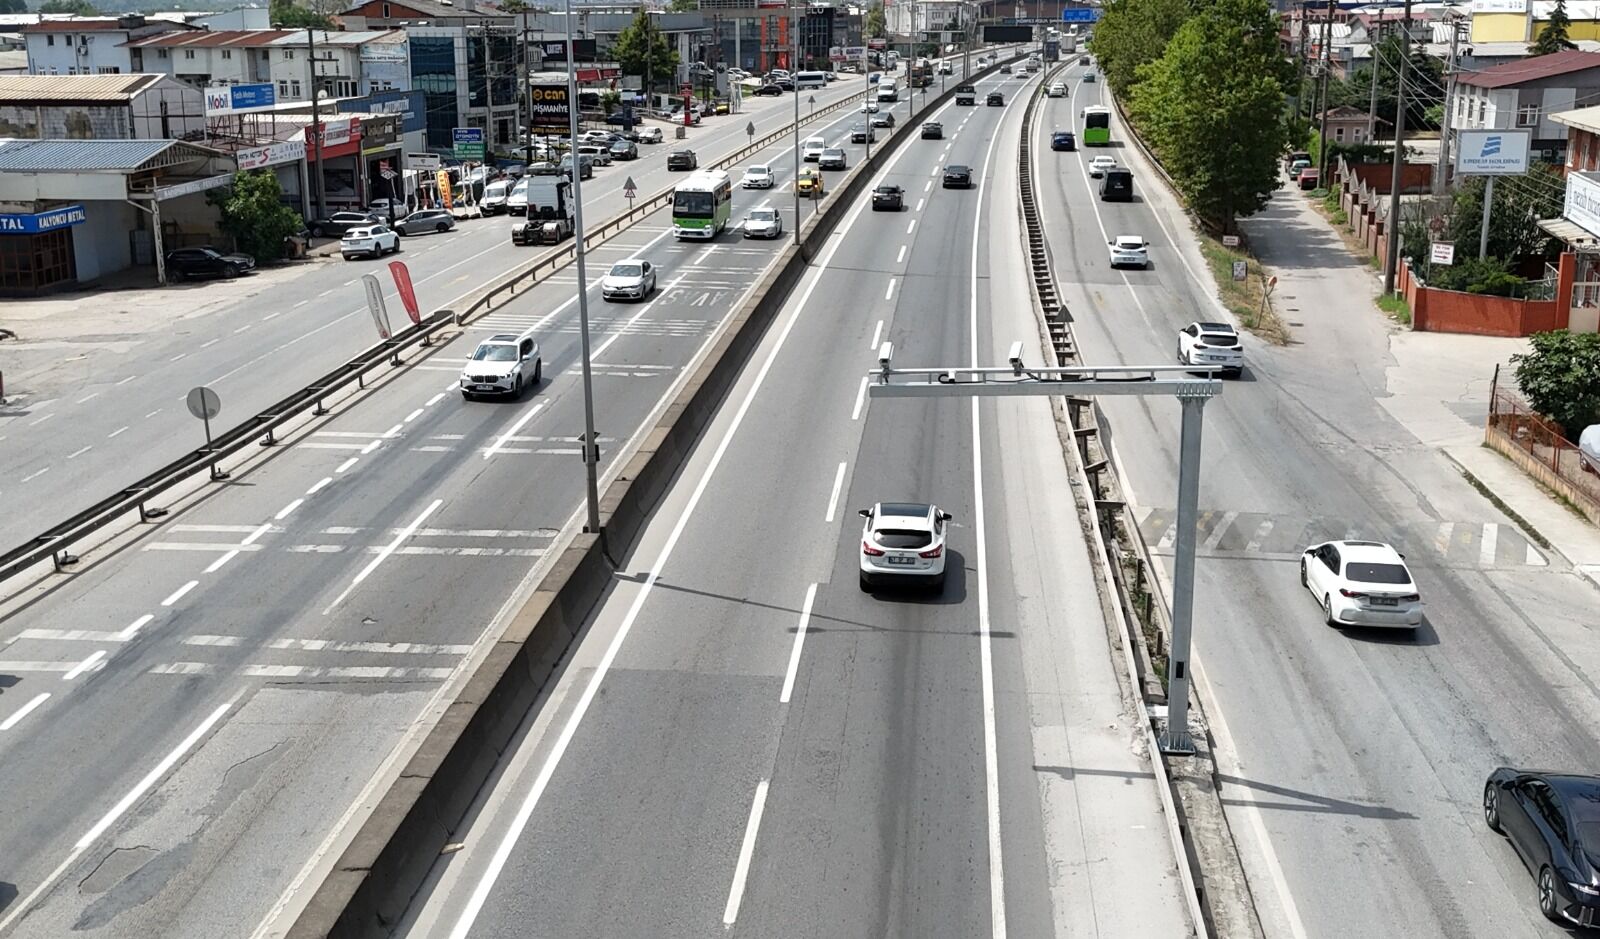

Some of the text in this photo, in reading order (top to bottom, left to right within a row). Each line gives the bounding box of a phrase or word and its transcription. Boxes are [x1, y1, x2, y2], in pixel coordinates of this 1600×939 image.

[208, 94, 228, 110] Mobil
[544, 90, 566, 100] can
[533, 103, 568, 115] PİŞMANİYE
[0, 209, 86, 230] TAL KALYONCU METAL
